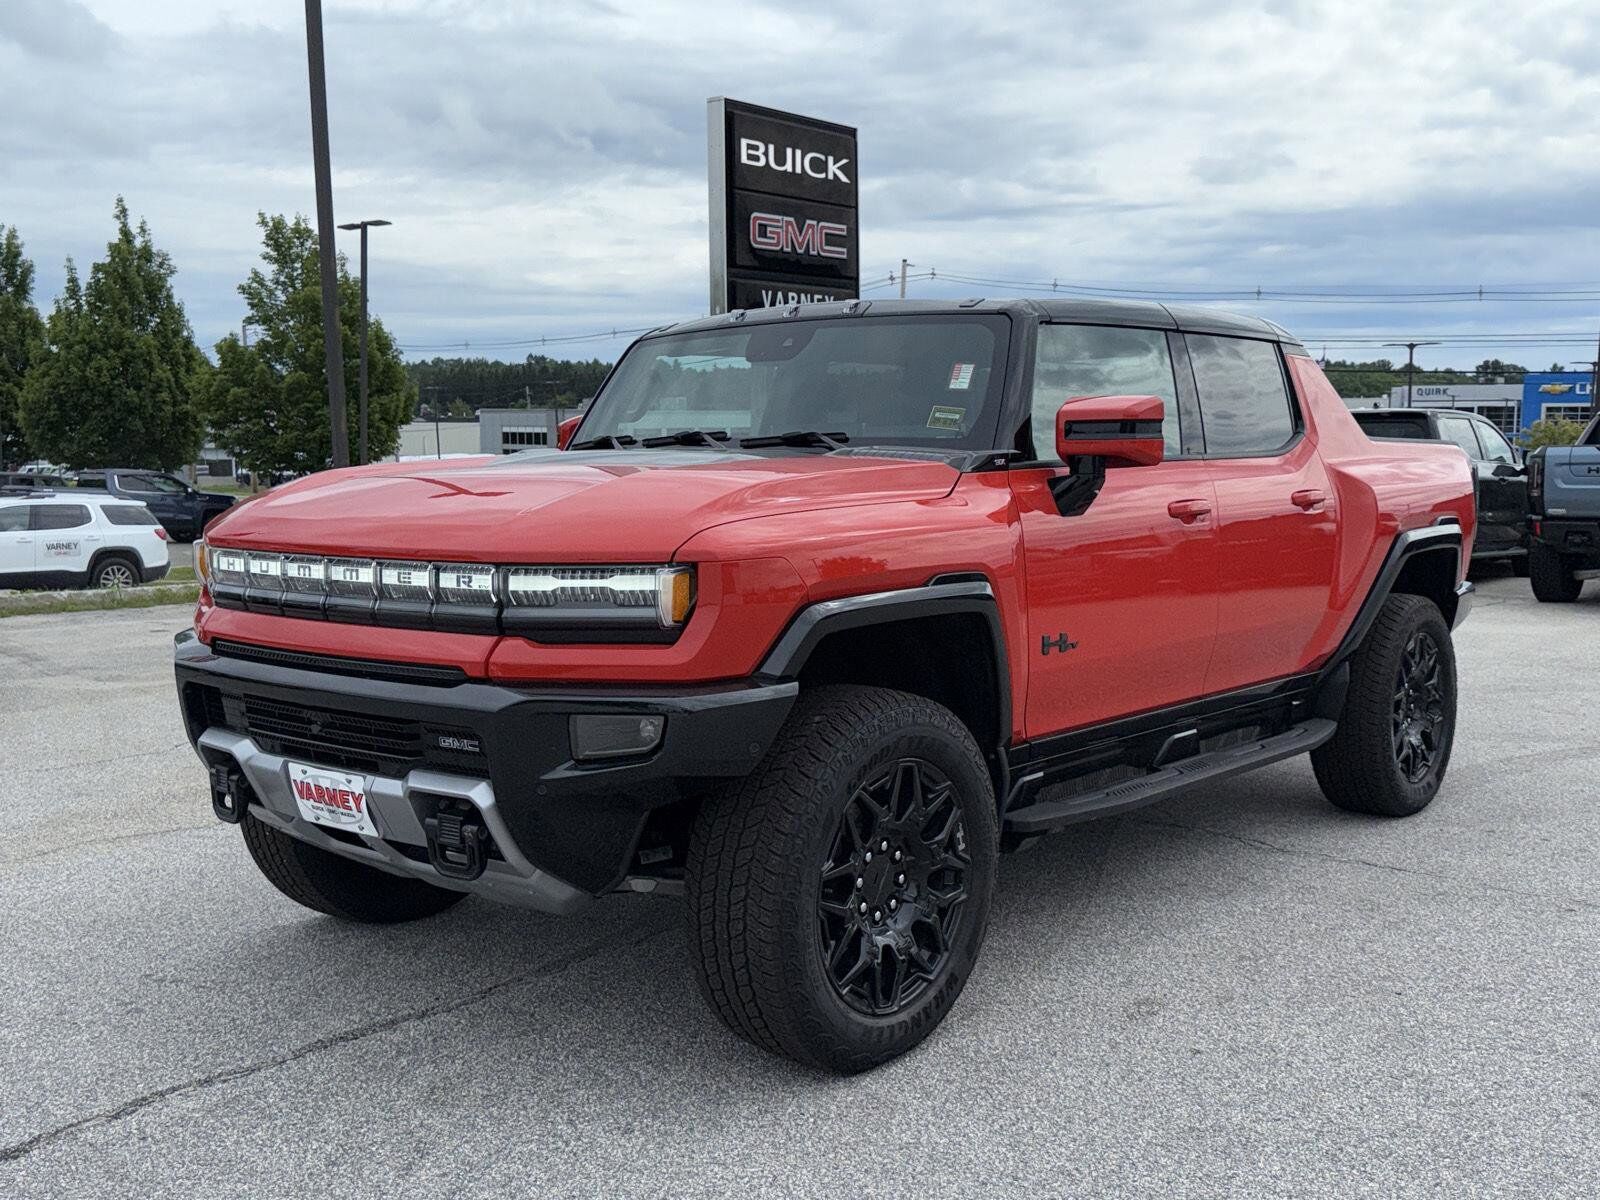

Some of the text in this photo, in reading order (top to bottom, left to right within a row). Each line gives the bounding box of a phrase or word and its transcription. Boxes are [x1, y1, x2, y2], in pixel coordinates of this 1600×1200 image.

[740, 138, 850, 183] BUICK
[751, 212, 848, 259] GMC
[1416, 387, 1449, 396] QUIRK
[45, 542, 78, 551] VARNEY
[227, 559, 473, 588] HUMMER
[439, 736, 480, 752] GMC
[292, 779, 364, 813] VARNEY
